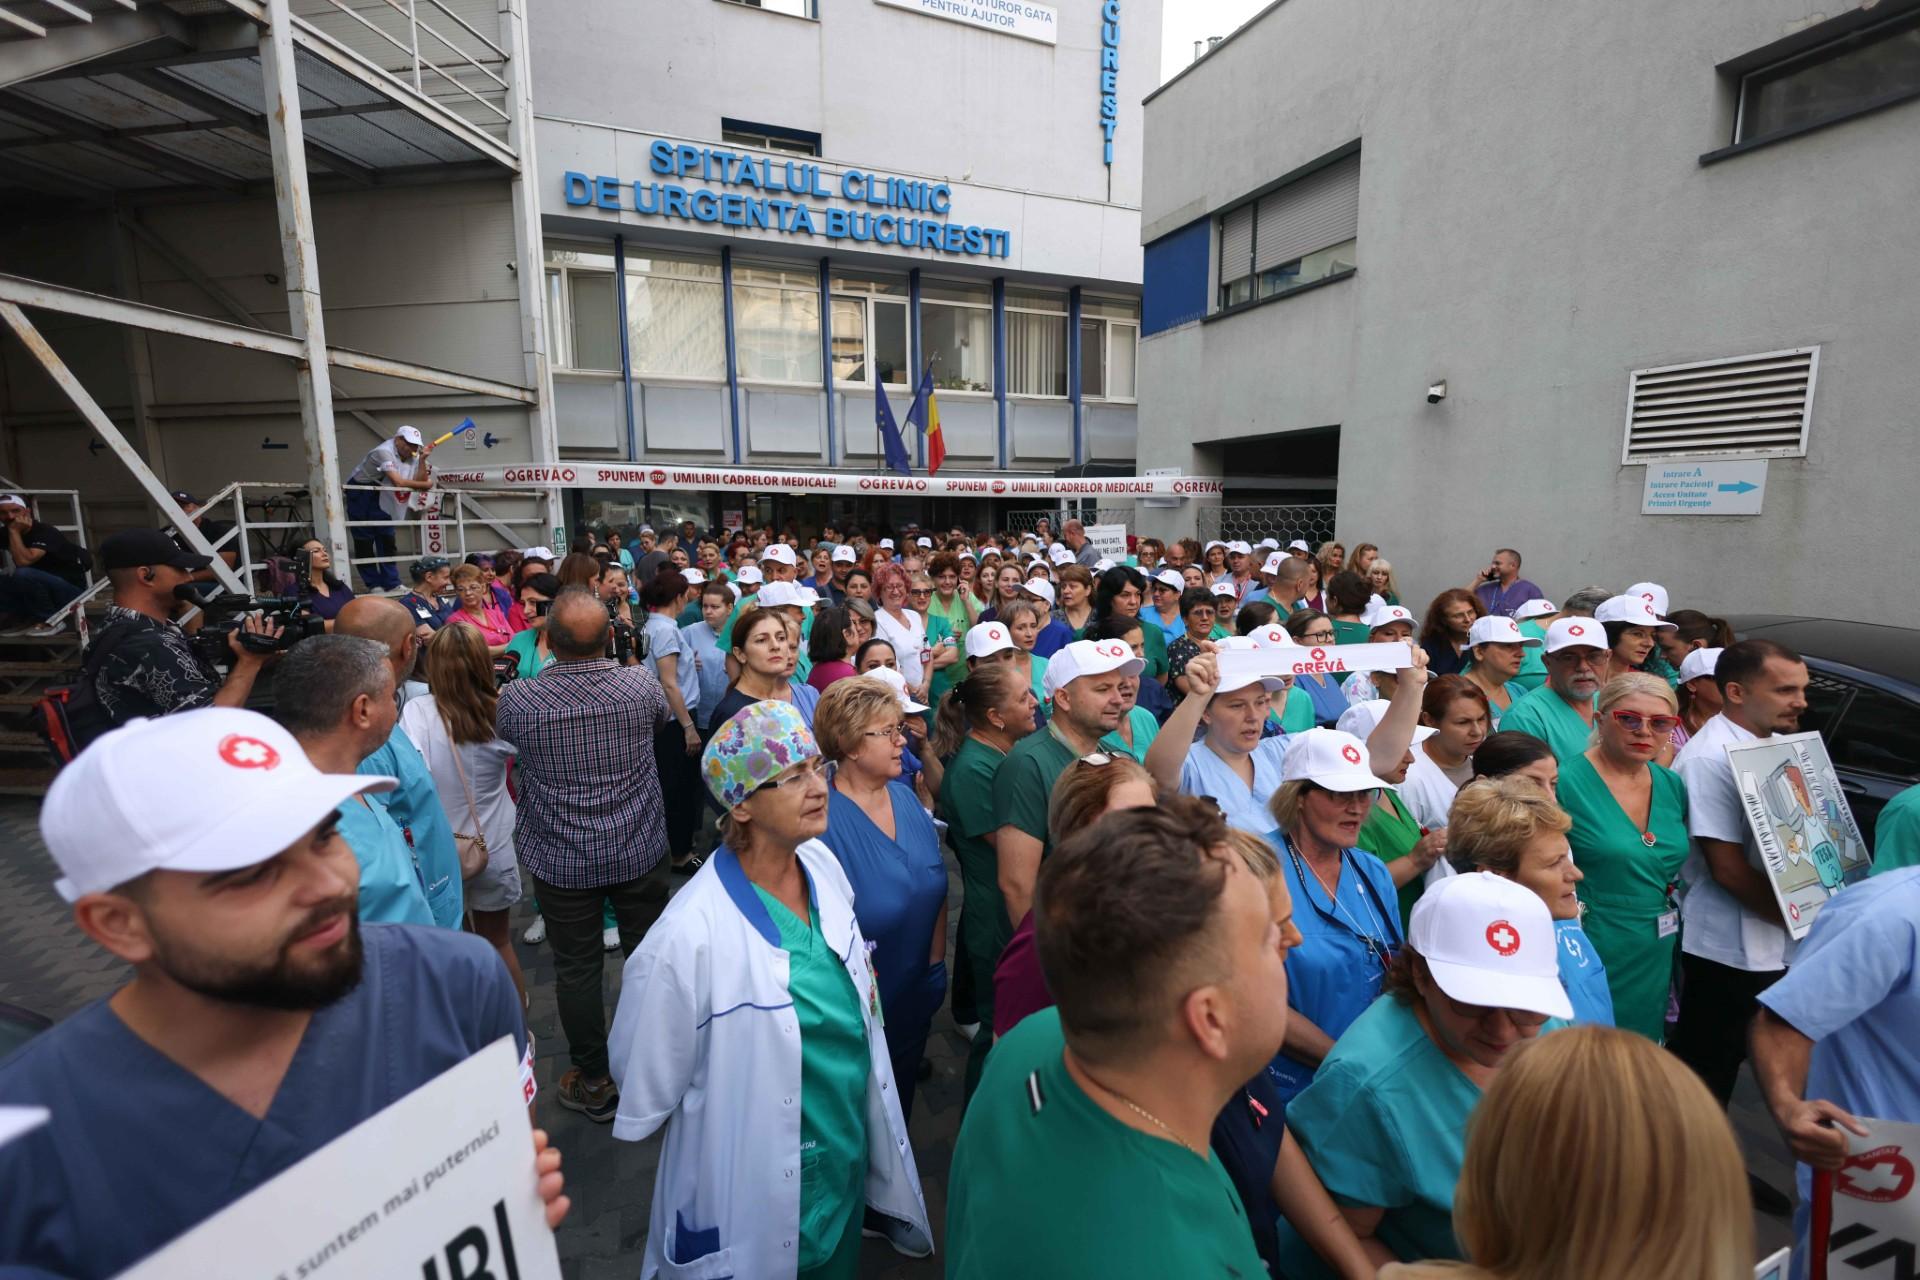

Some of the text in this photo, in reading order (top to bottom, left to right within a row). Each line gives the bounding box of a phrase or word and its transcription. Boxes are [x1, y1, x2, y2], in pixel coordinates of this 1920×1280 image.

[971, 0, 1053, 24] UTUROR GATA
[971, 8, 1015, 28] AJUTOR
[650, 140, 952, 215] SPITALUL CLINIC
[564, 170, 1011, 258] DE URGENTA BUCURESTI
[598, 470, 645, 482] SPUNEM
[673, 472, 720, 484] UMILIRII
[722, 474, 779, 486] CADRELOR
[781, 476, 837, 488] MEDICALE!
[1693, 467, 1702, 477] A
[946, 480, 987, 492] SPUNEM
[1012, 482, 1052, 493] UMILIRII
[1054, 482, 1103, 493] CADRELOR
[1105, 482, 1154, 493] MEDICALE!
[1292, 658, 1346, 674] GREVĂ
[297, 1121, 500, 1280] suntem mai puternici
